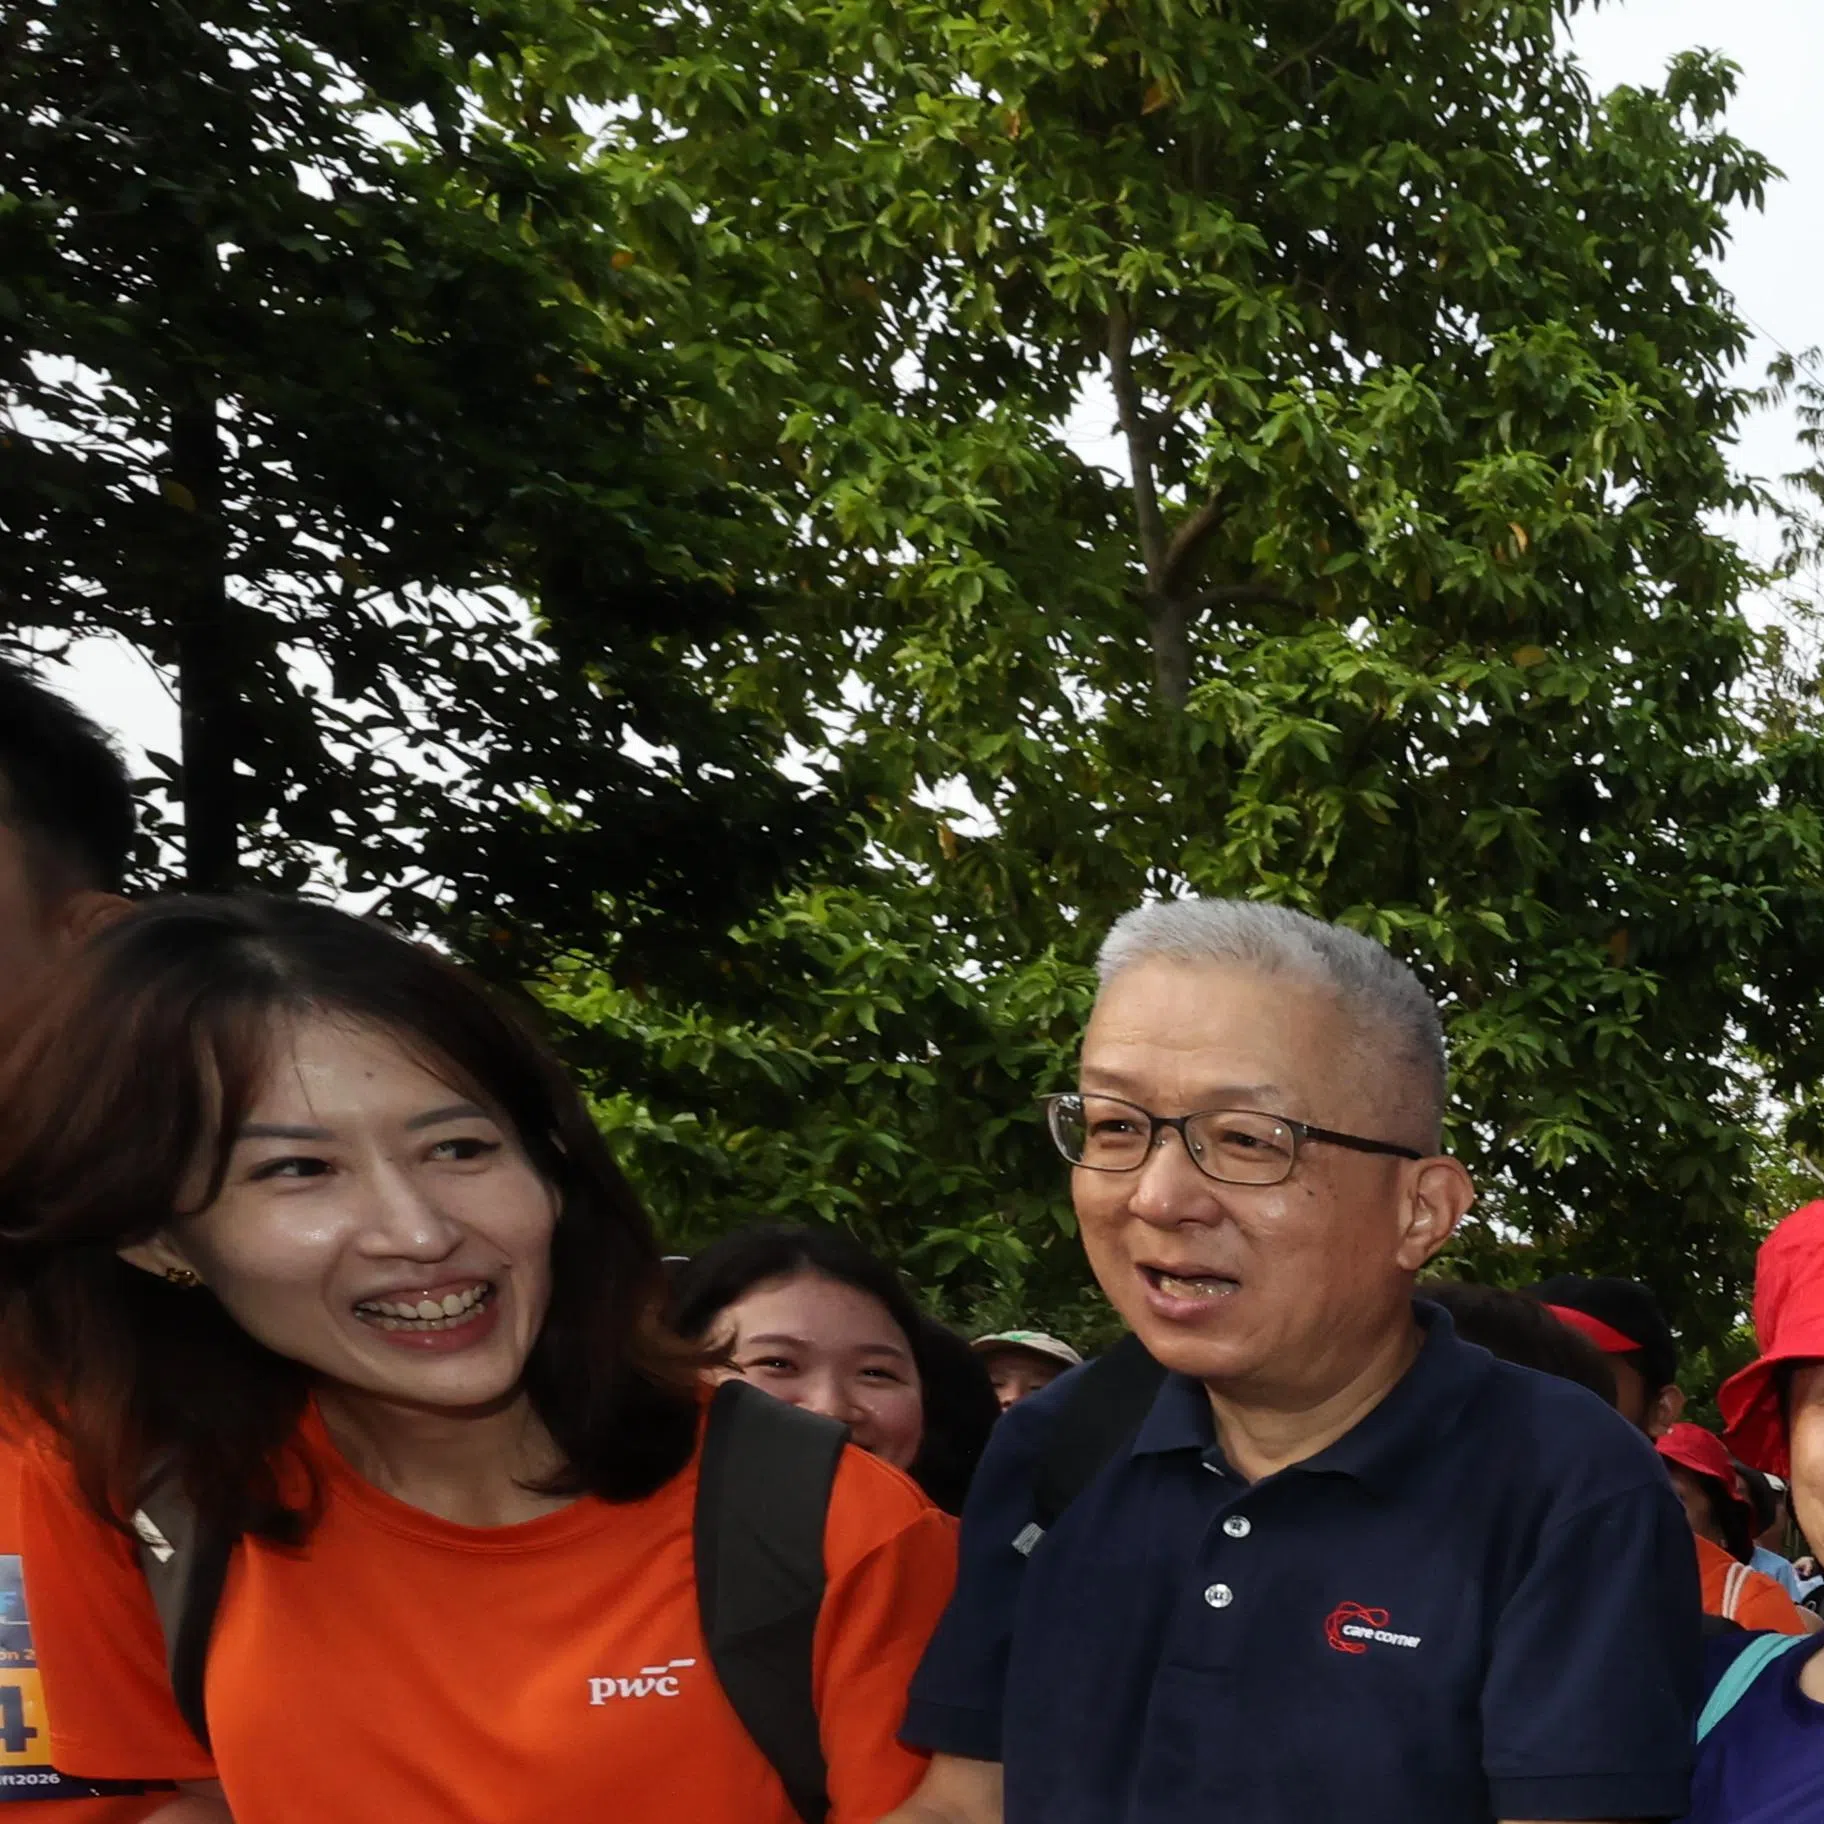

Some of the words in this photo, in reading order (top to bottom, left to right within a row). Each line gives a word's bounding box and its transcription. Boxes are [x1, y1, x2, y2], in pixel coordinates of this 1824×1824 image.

[1342, 1624, 1374, 1639] care
[1374, 1630, 1422, 1649] corner
[588, 1676, 679, 1706] pwc
